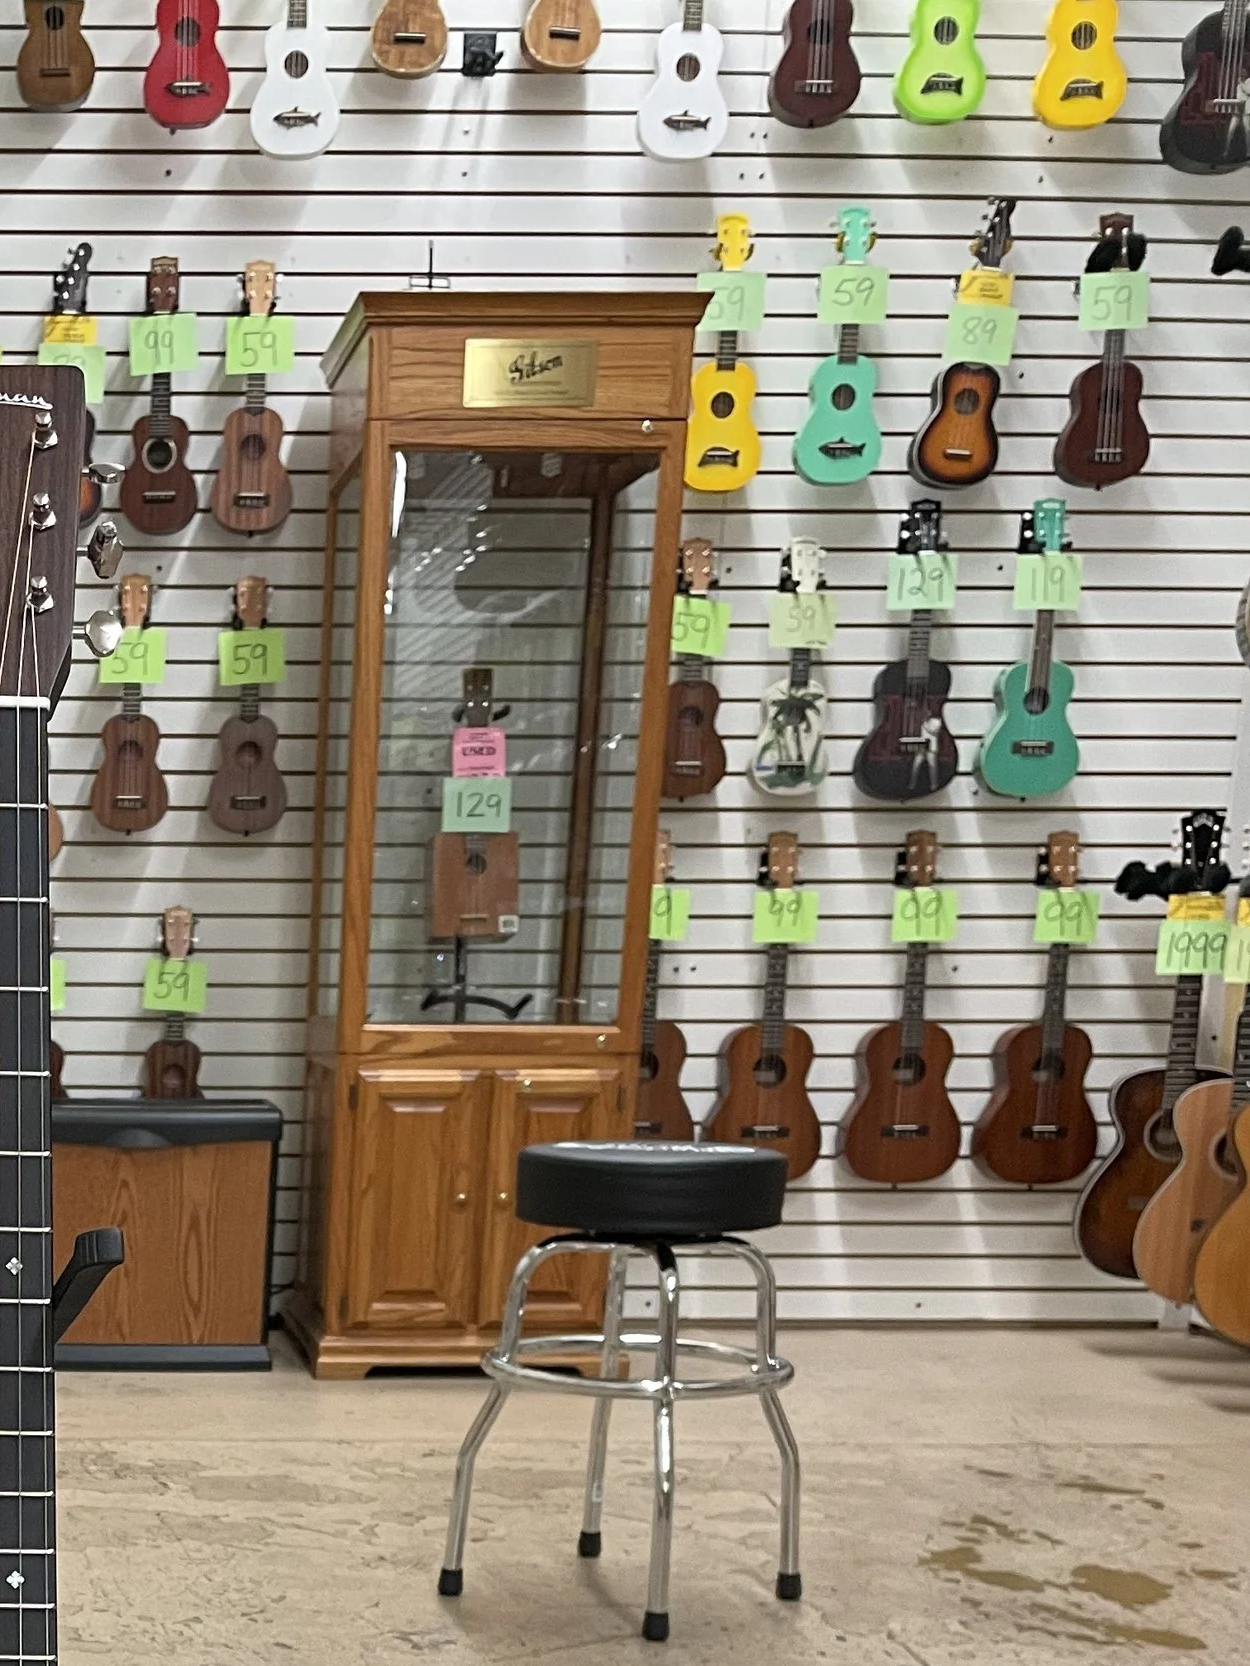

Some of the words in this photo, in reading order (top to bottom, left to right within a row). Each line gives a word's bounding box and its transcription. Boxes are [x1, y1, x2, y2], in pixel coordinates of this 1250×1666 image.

[706, 285, 745, 322] 59
[831, 276, 875, 307] 59
[1091, 285, 1133, 321] 59
[145, 330, 175, 366] 99
[962, 316, 997, 345] 89
[239, 331, 278, 367] 59
[897, 567, 945, 602] 129
[1032, 565, 1066, 602] 119
[670, 612, 711, 649] 59
[785, 604, 816, 633] 59
[111, 642, 149, 676] 59
[232, 643, 268, 676] 59
[456, 791, 502, 818] 129
[900, 896, 943, 937] 99
[1044, 901, 1083, 937] 99
[1166, 931, 1227, 971] 1999
[153, 971, 190, 1001] 59
